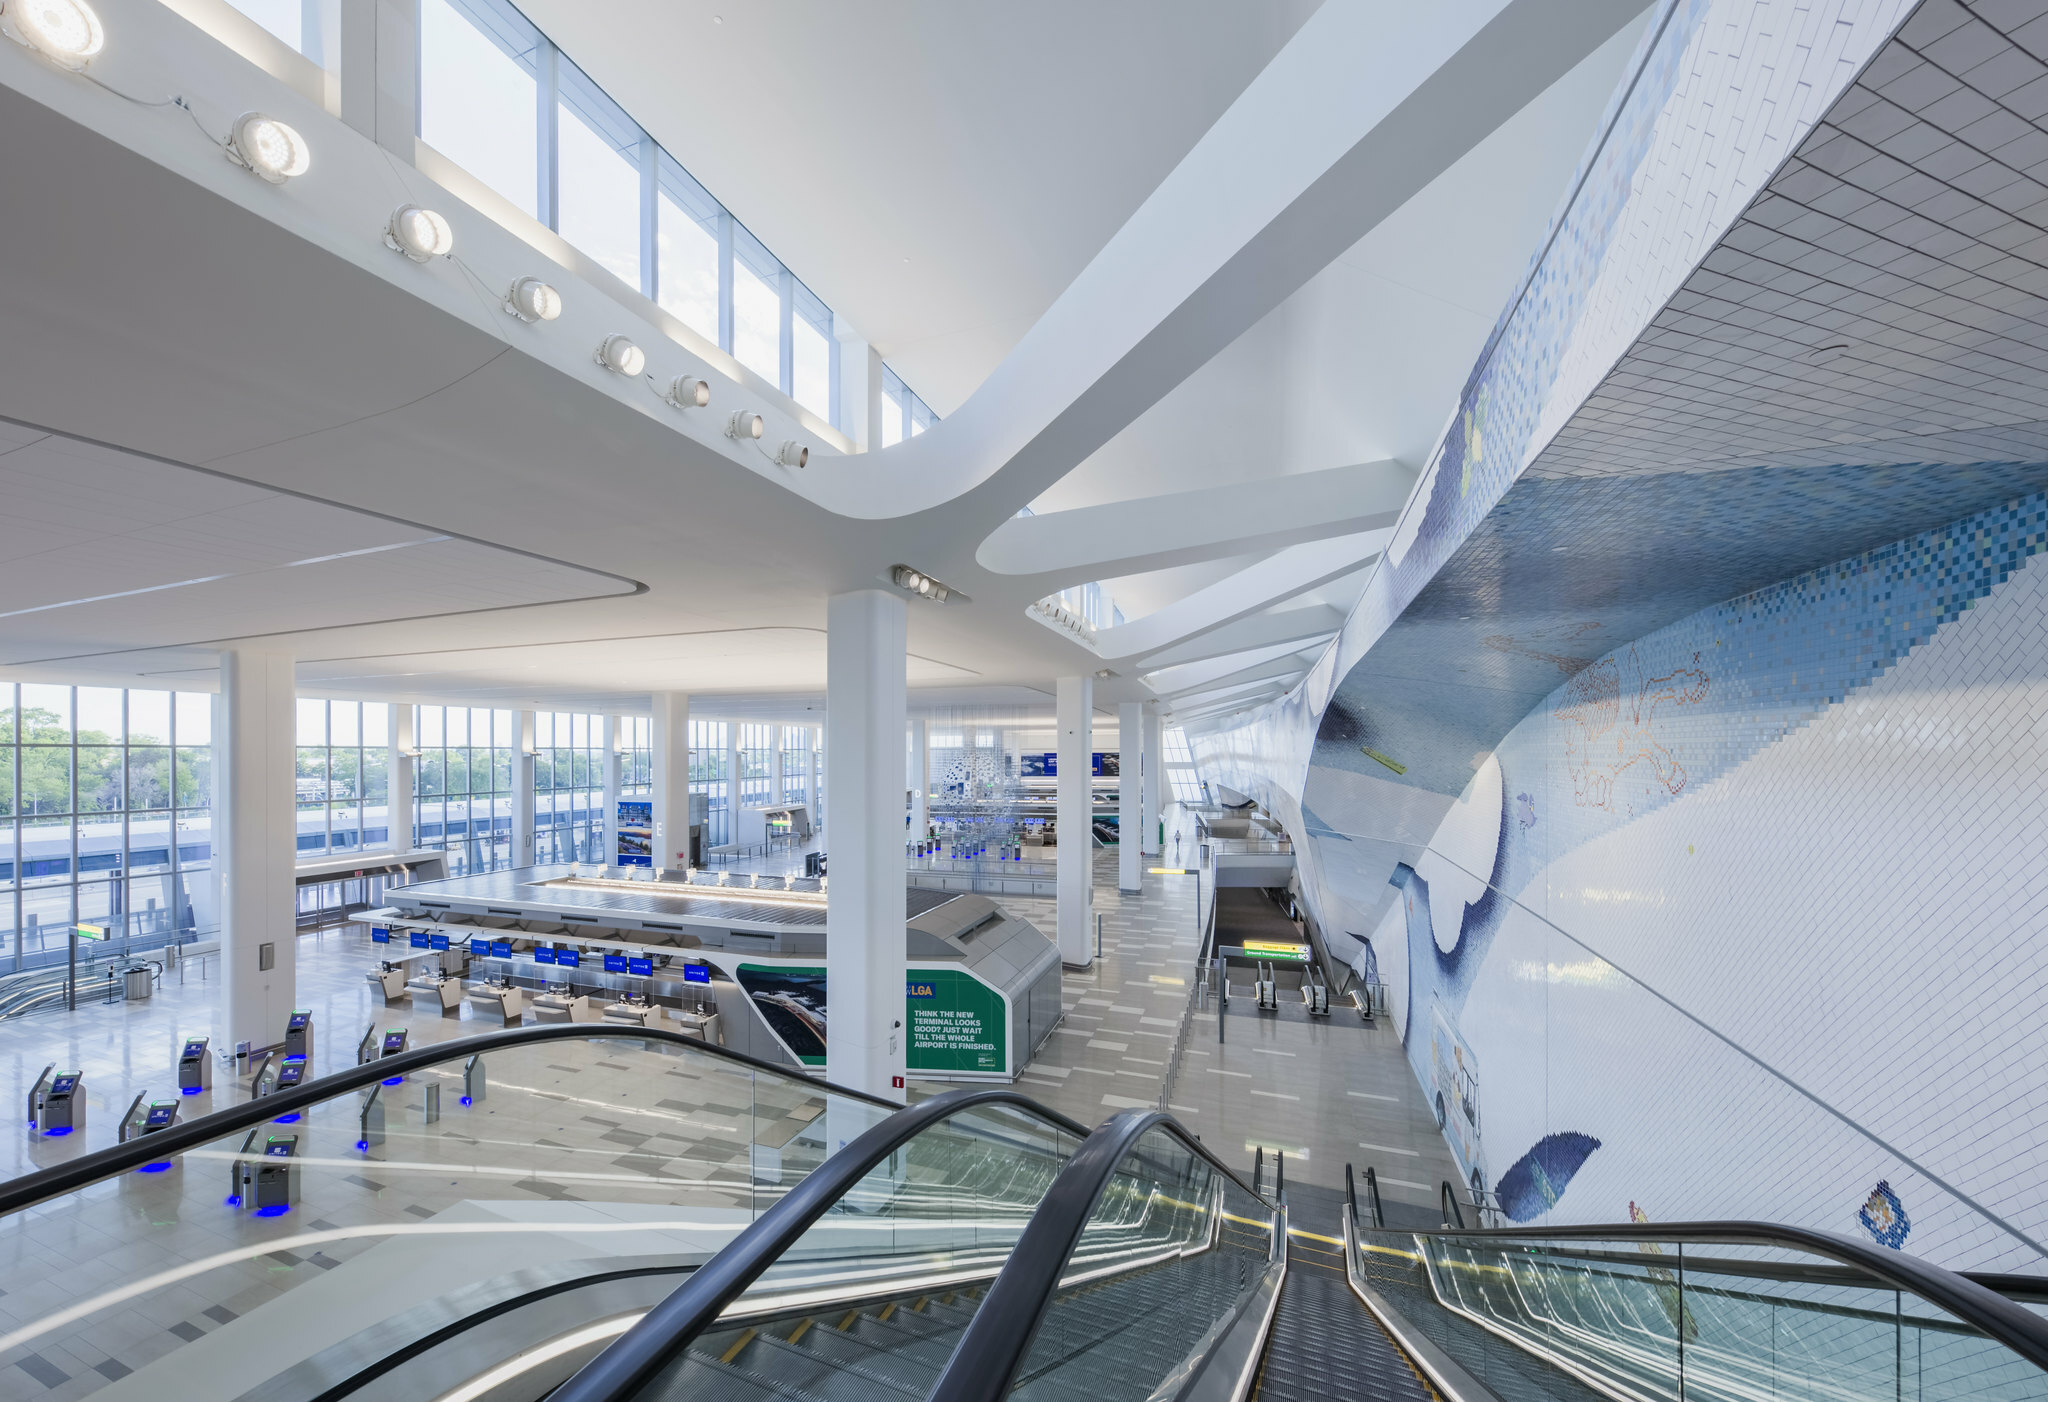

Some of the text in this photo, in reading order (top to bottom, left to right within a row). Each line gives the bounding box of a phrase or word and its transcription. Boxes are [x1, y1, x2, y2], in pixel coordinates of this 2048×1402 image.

[656, 822, 662, 837] E
[911, 986, 932, 996] LGA
[940, 1010, 955, 1018] THE
[914, 1018, 953, 1026] TERMINAL
[942, 1026, 960, 1034] JUST
[947, 1034, 975, 1042] WHOLE
[914, 1041, 949, 1049] AIRPORT
[958, 1043, 997, 1051] FINISHED.
